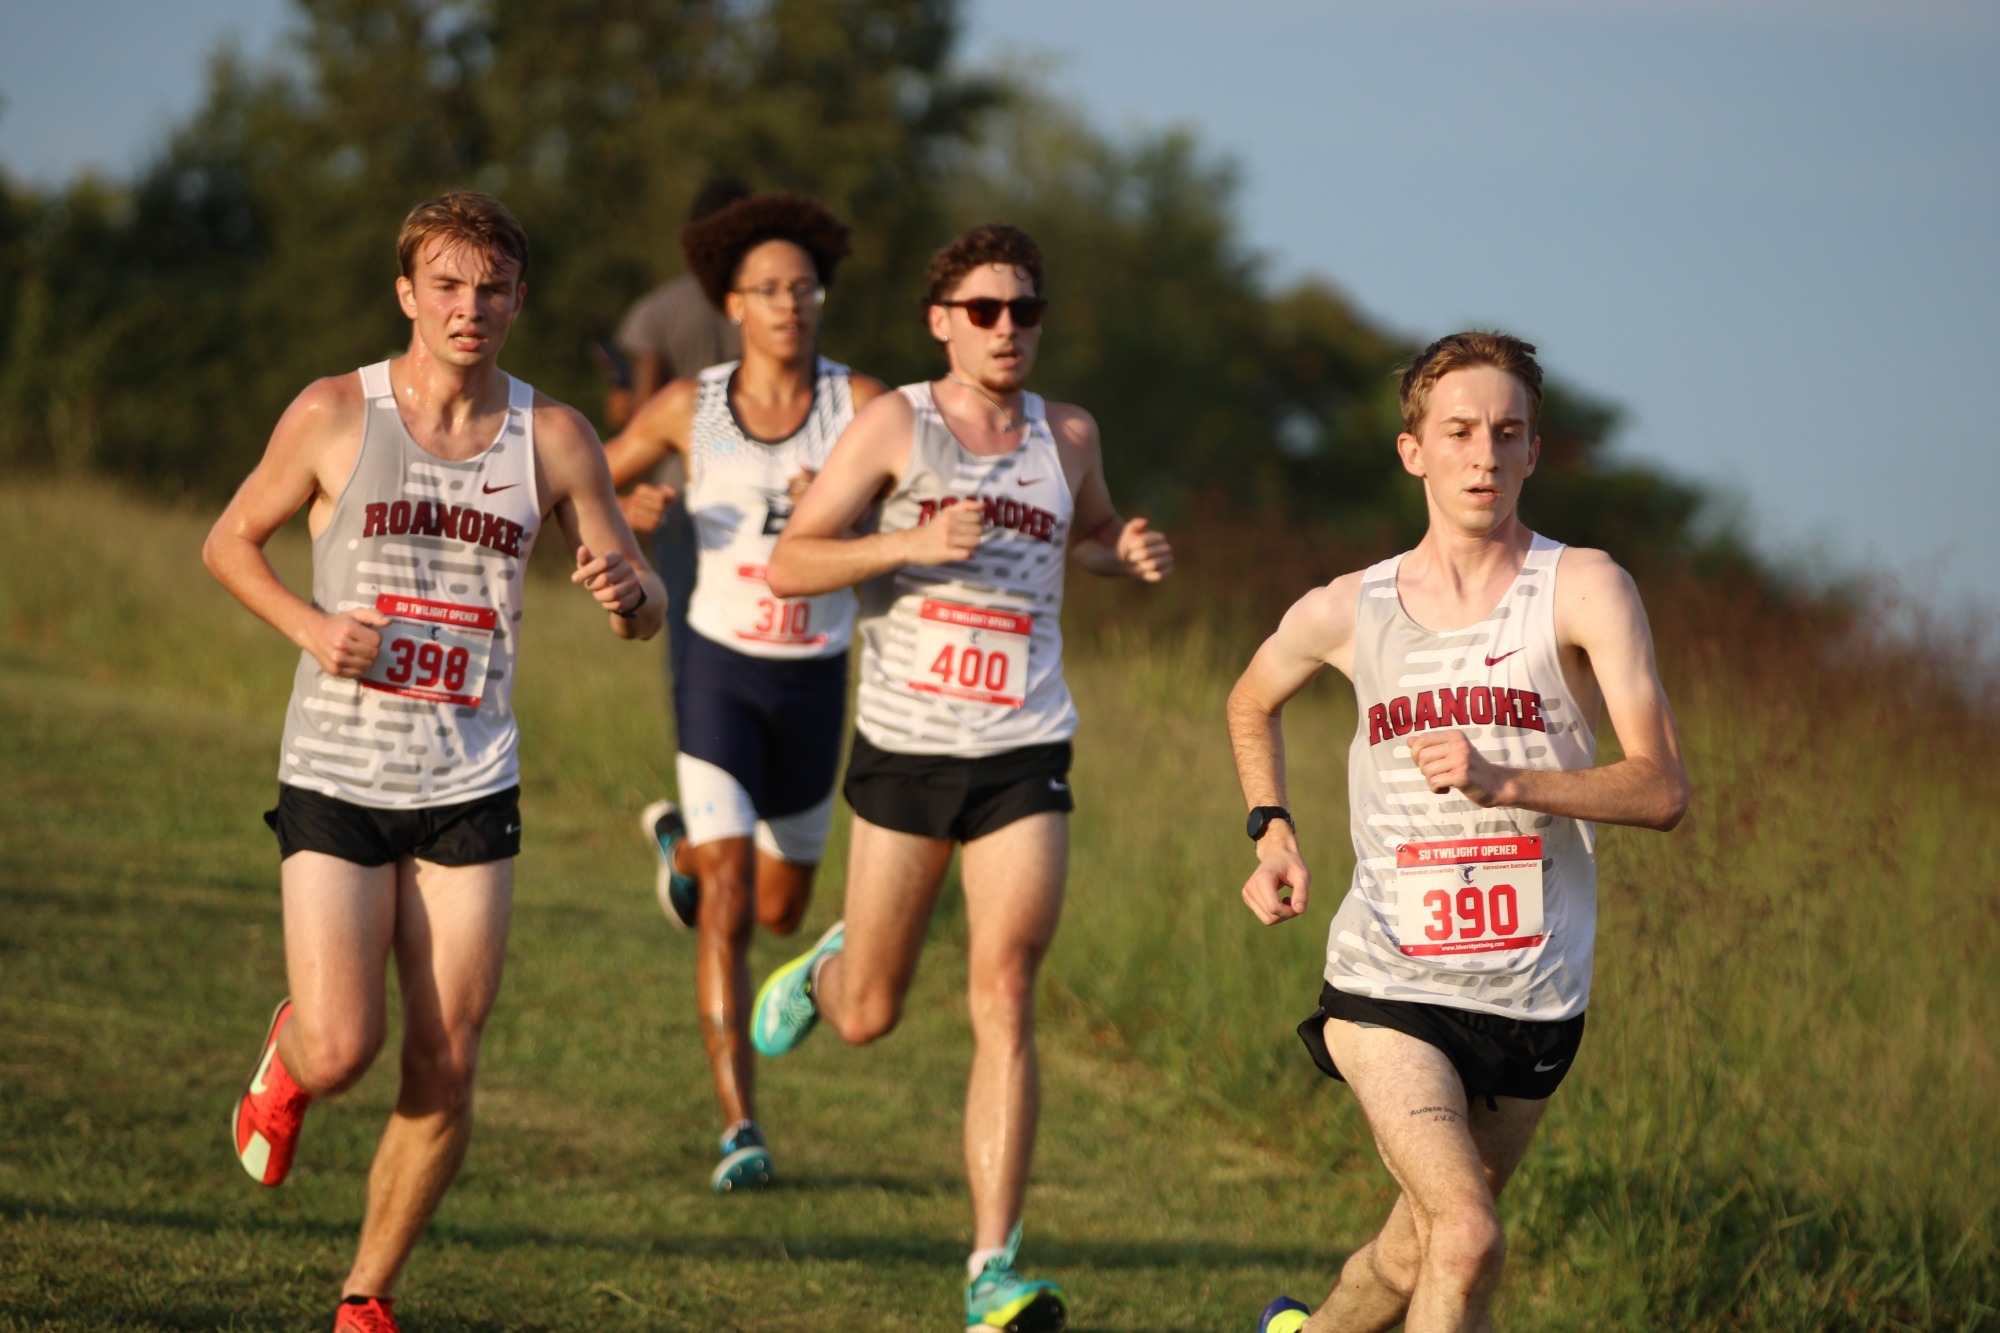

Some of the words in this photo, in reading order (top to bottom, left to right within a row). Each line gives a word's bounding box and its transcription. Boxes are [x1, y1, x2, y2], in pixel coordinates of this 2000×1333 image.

[363, 500, 524, 559] ROANOKE
[918, 495, 1057, 542] RNOKE
[396, 602, 408, 613] SU
[409, 604, 448, 619] TWILIGHT
[449, 610, 479, 624] OPENER
[755, 599, 810, 636] 310
[951, 609, 988, 626] TWILIGHT
[988, 616, 1017, 631] OPENER
[386, 638, 470, 692] 398
[930, 644, 1009, 692] 400
[1368, 686, 1546, 746] ROANOKE
[1418, 849, 1431, 861] SU
[1433, 846, 1478, 860] TWILIGHT
[1481, 844, 1518, 857] OPENER
[1423, 884, 1519, 942] 390
[1441, 941, 1505, 951] www.blueridgetiming.com
